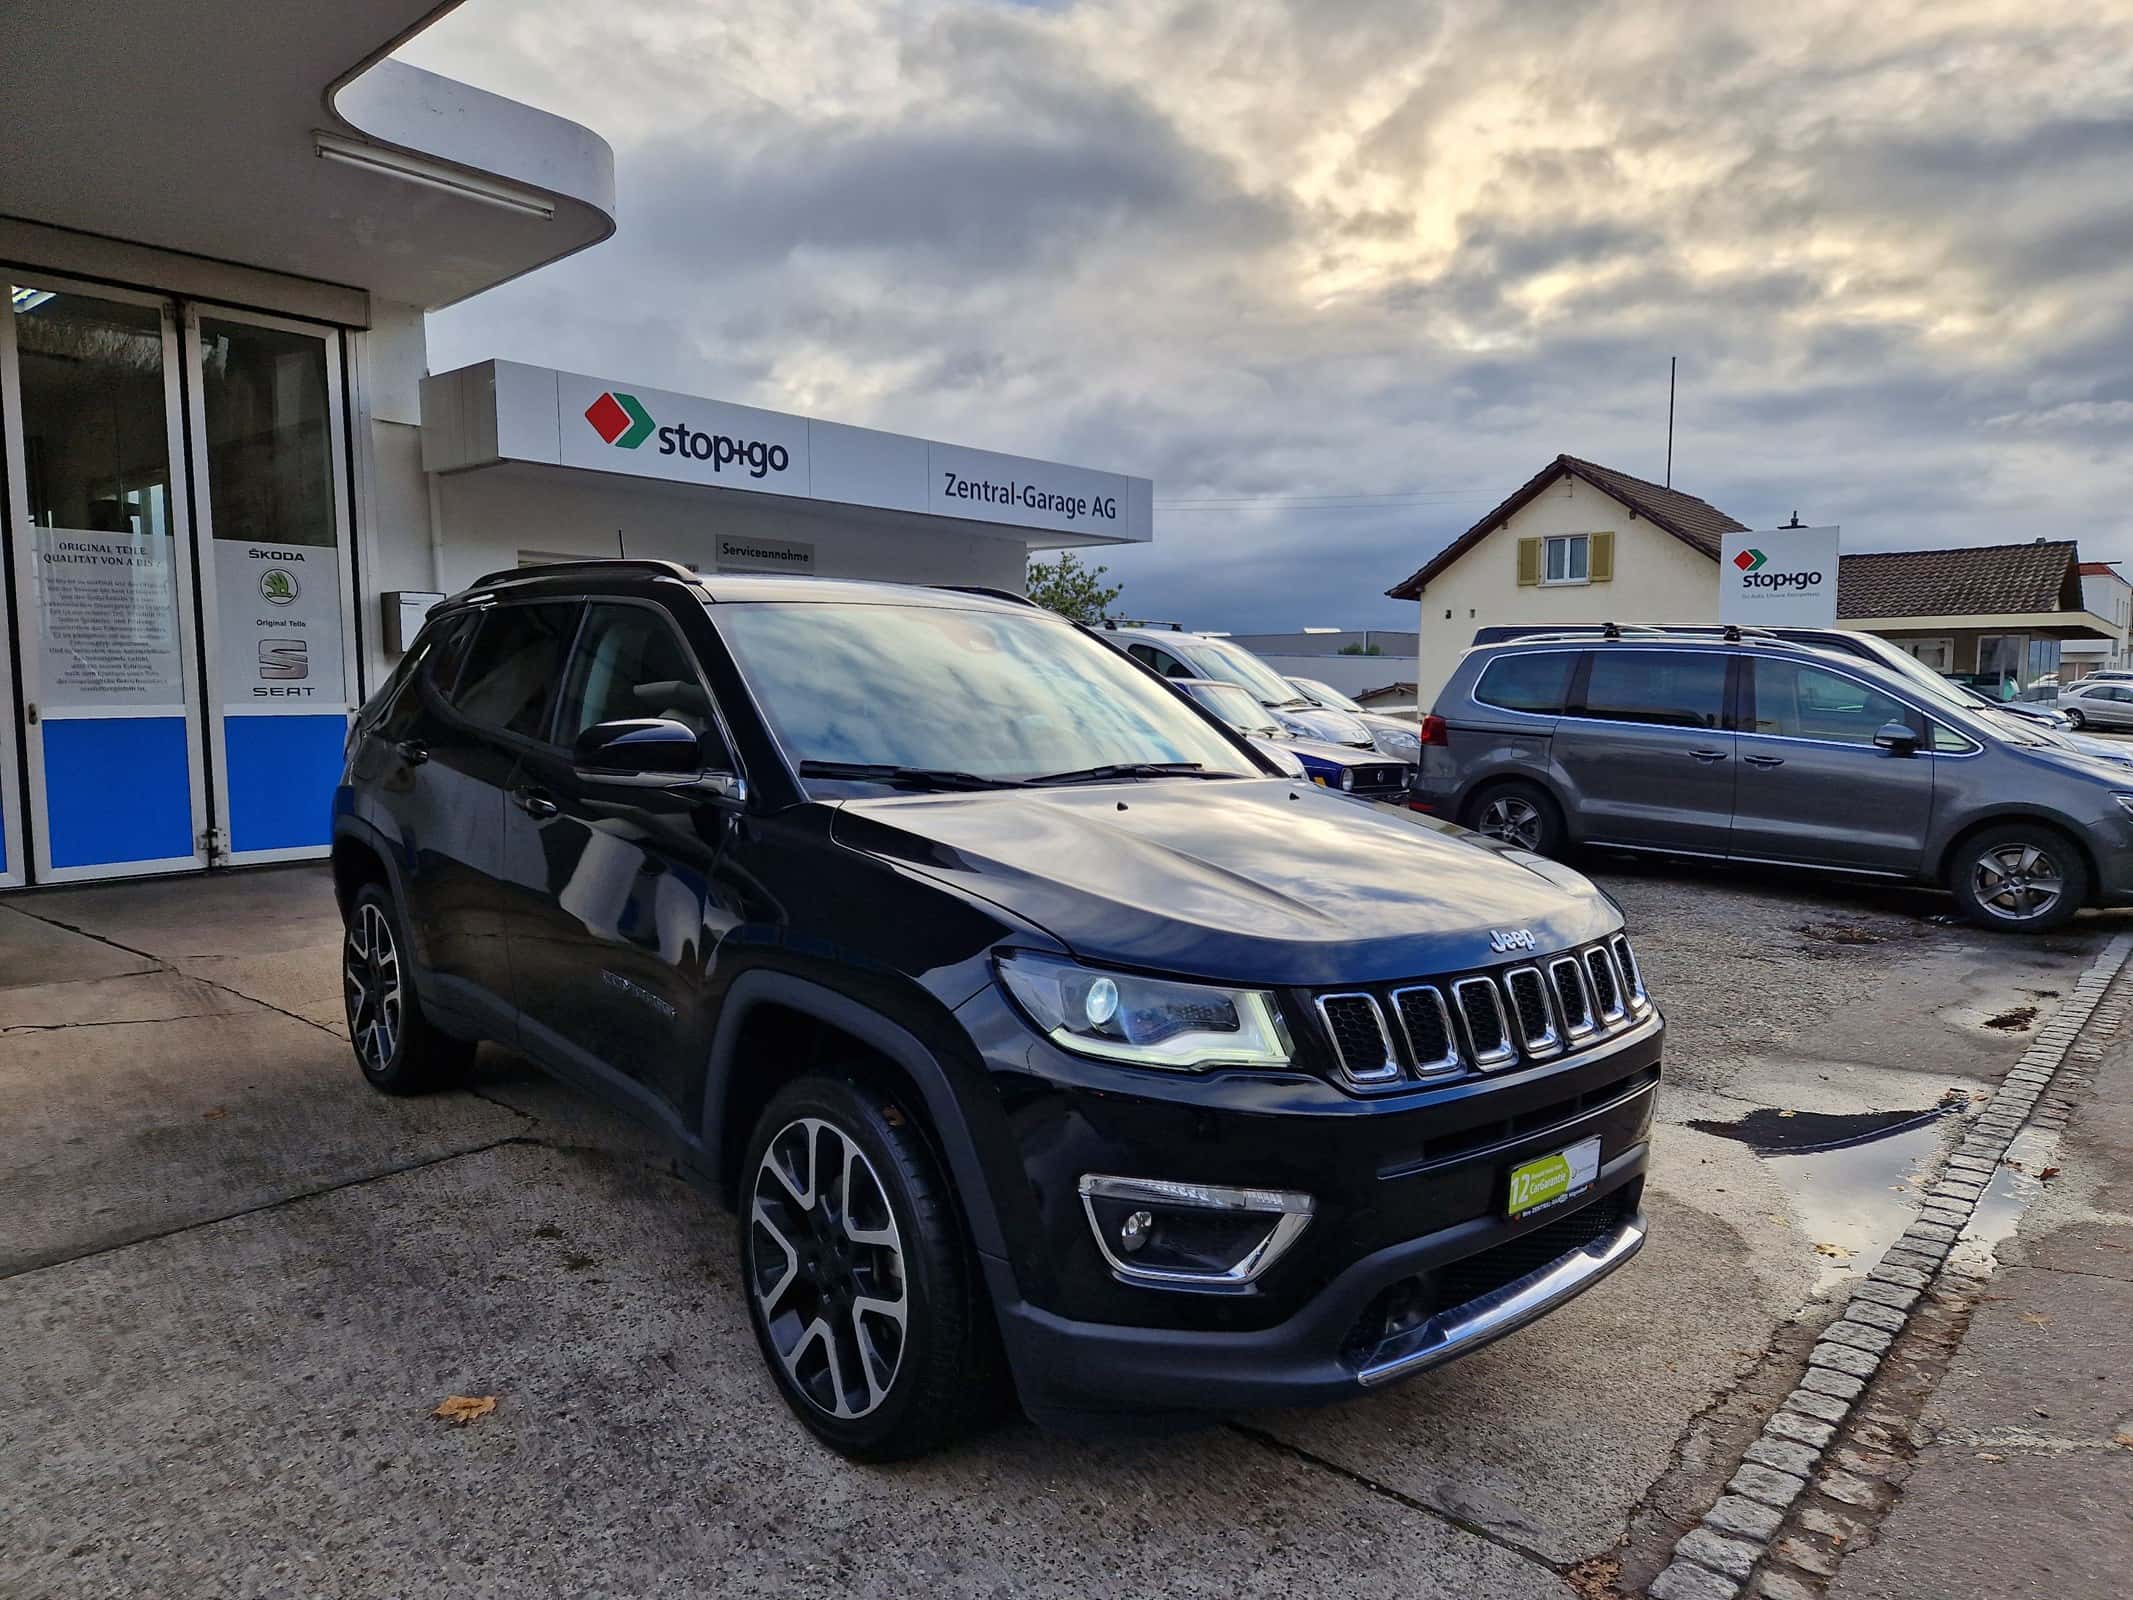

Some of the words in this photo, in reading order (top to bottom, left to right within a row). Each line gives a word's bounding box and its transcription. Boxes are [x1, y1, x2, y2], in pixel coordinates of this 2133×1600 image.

[657, 422, 789, 479] stop+go
[944, 472, 1087, 520] Zentral-Garage
[1091, 496, 1117, 520] AG
[59, 542, 112, 554] ORIGINAL
[249, 548, 306, 562] ŠKODA
[722, 542, 809, 562] Serviceannahme
[100, 556, 124, 566] VON
[126, 557, 133, 567] A
[1743, 571, 1822, 591] stop+go
[256, 619, 287, 629] Original
[289, 619, 307, 628] Teile
[252, 687, 315, 697] SEAT
[1489, 929, 1536, 953] Jeep
[1511, 1173, 1530, 1206] 12
